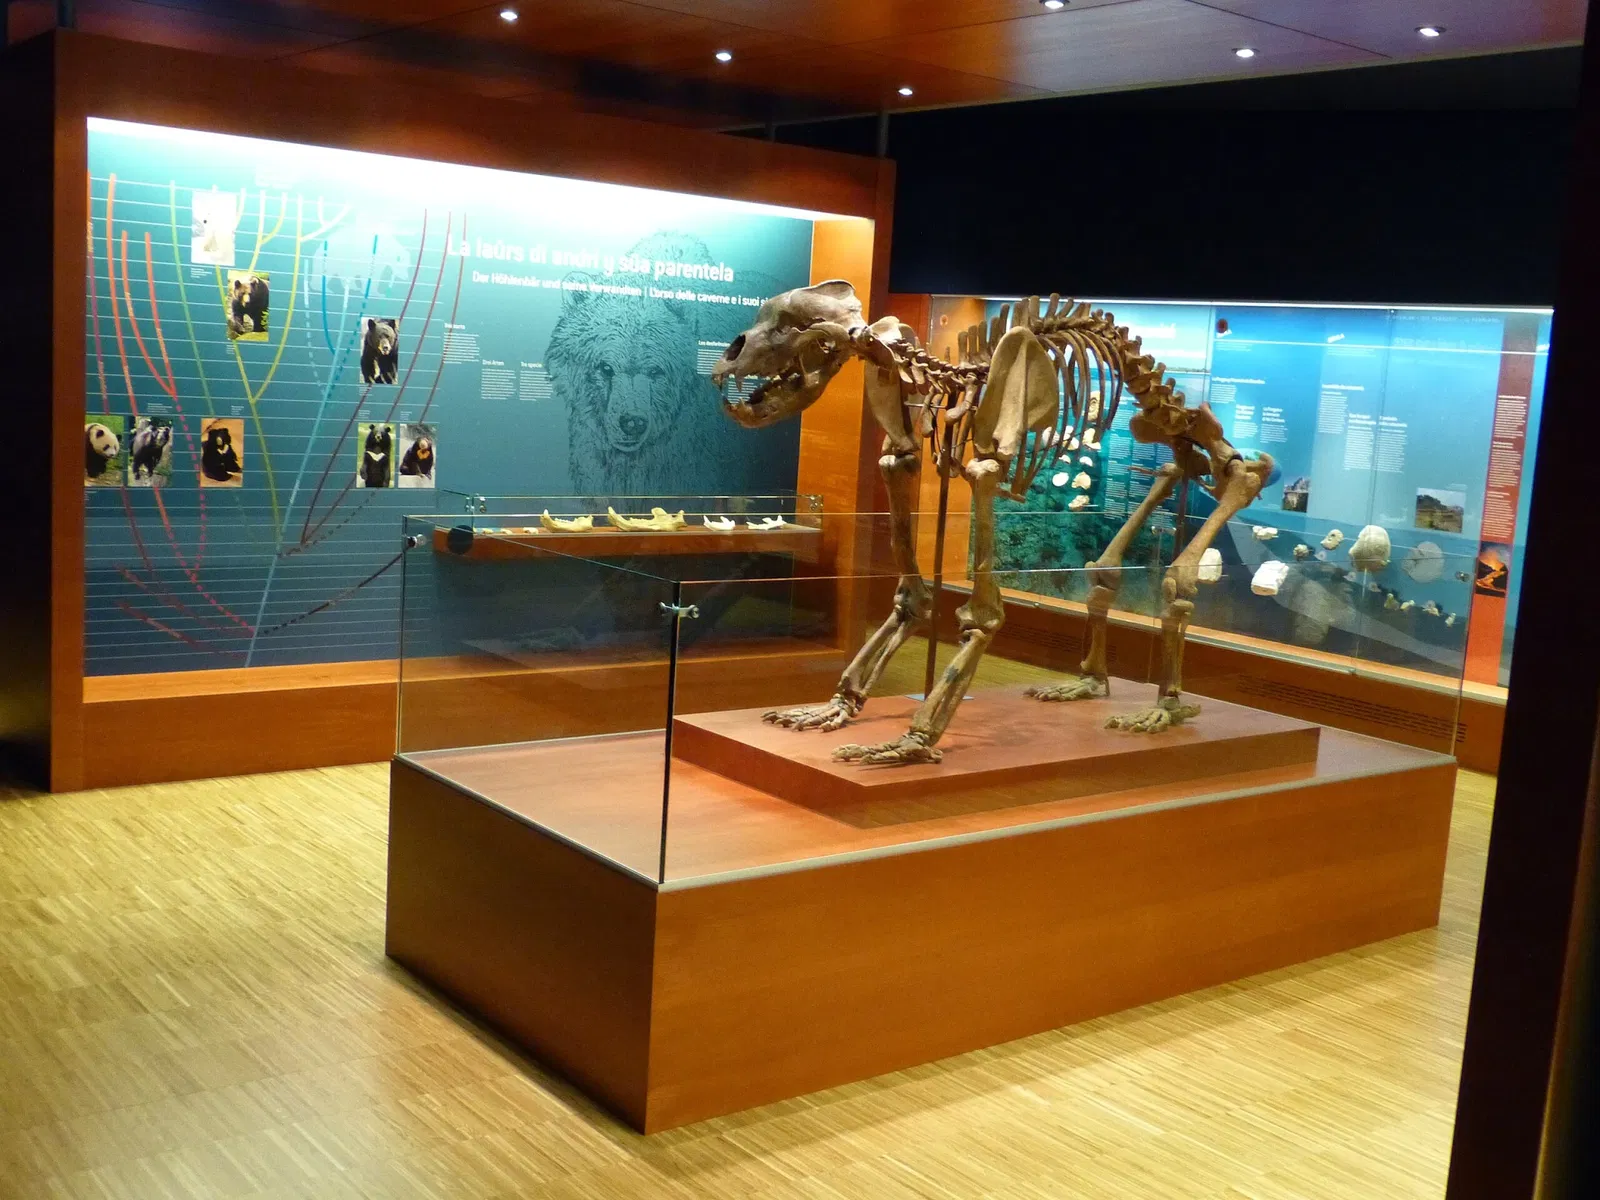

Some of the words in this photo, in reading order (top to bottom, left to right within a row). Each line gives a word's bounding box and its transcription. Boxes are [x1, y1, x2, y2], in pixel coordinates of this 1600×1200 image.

[447, 233, 471, 257] La
[529, 243, 547, 264] di
[603, 255, 614, 277] y
[654, 260, 734, 282] parentela
[472, 270, 489, 282] Der
[542, 277, 561, 289] und
[676, 289, 696, 301] delle
[697, 293, 730, 304] caverne
[731, 296, 737, 304] e
[742, 295, 759, 306] suoi
